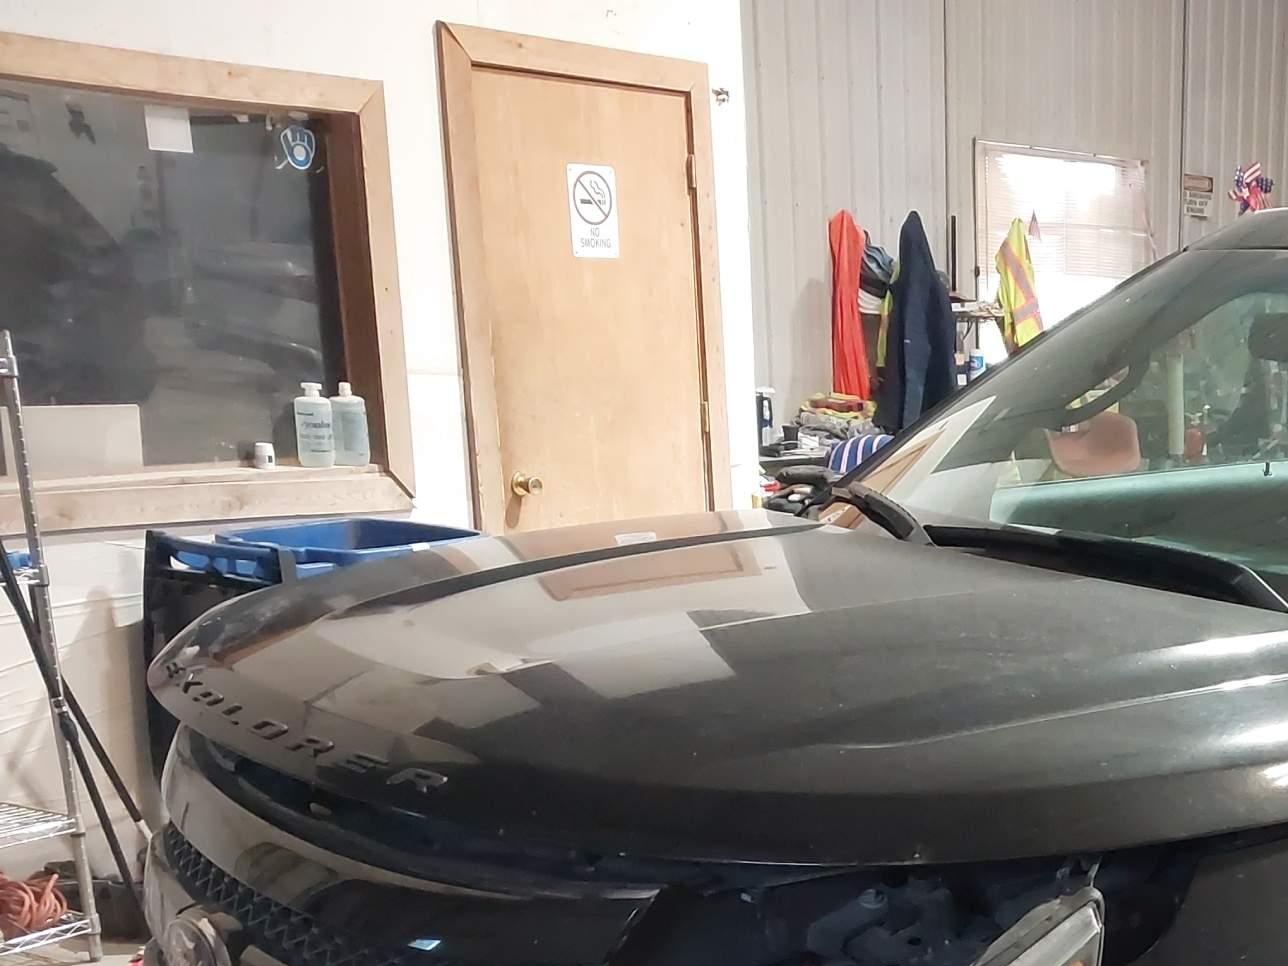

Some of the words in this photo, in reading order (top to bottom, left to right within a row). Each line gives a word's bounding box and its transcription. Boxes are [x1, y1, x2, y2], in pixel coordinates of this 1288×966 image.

[590, 227, 601, 238] NO
[580, 238, 612, 249] SMOKING
[165, 661, 449, 794] EXPLORER
